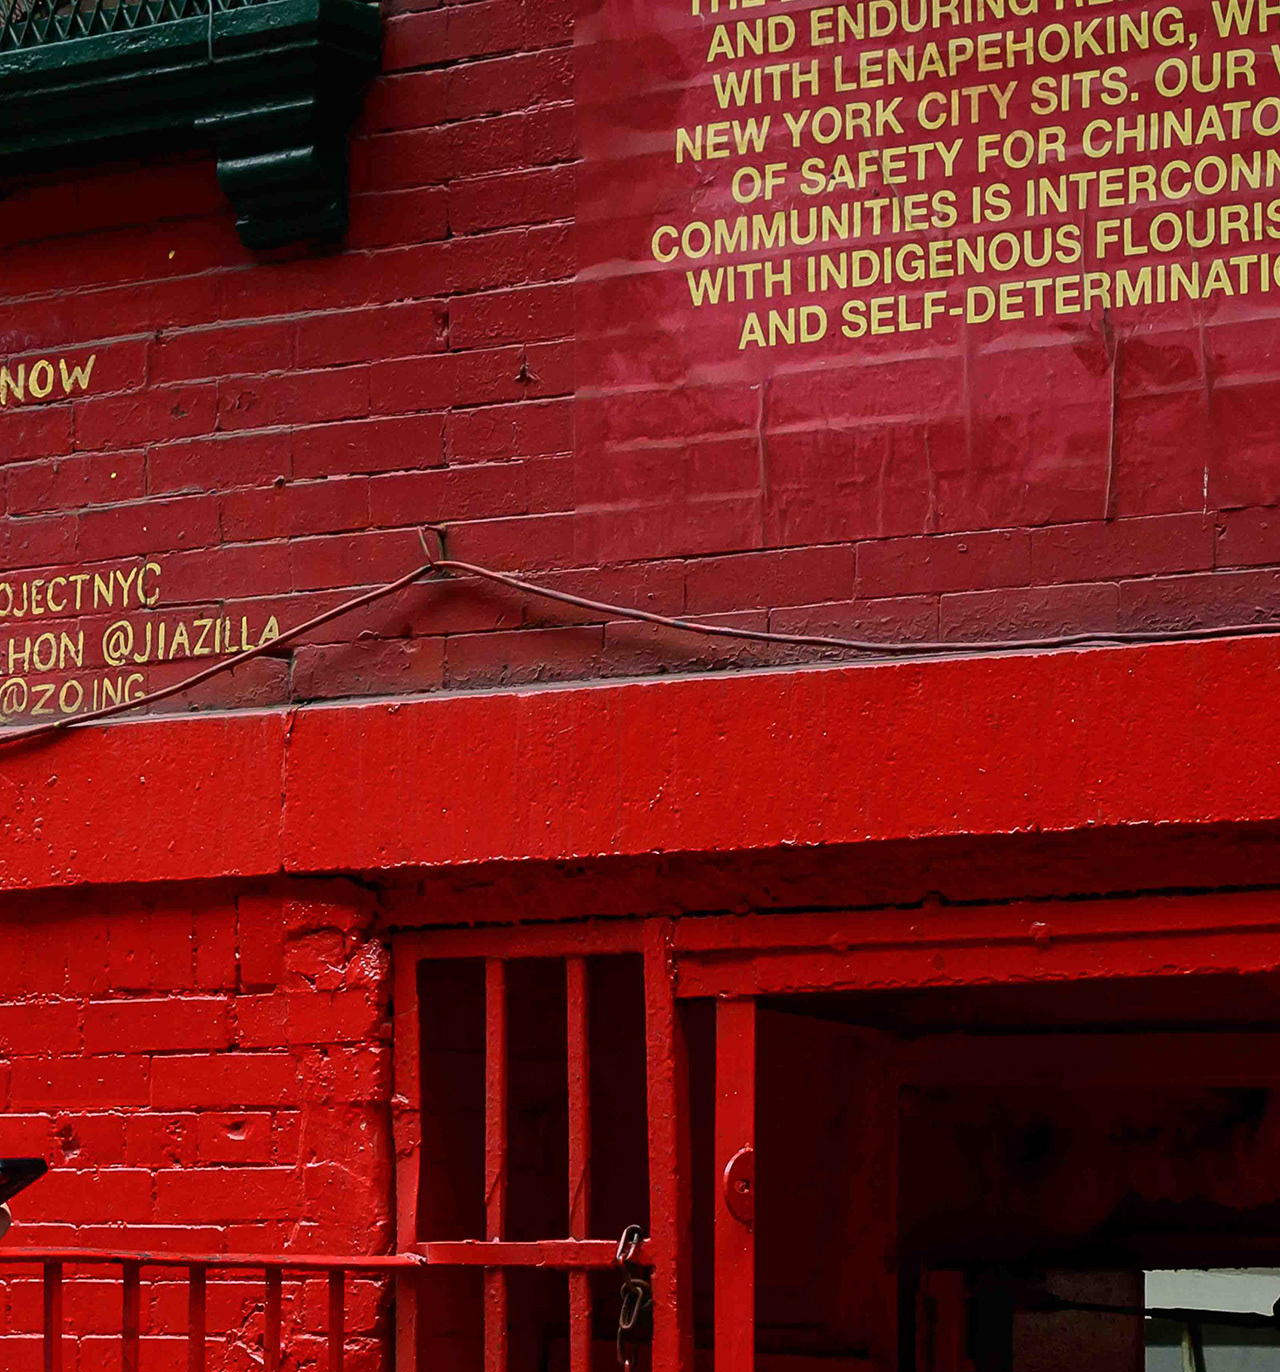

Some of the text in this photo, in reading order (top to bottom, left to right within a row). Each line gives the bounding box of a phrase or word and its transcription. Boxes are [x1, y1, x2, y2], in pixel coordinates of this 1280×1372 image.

[706, 15, 796, 62] AND
[712, 60, 819, 109] WITH
[834, 8, 1198, 92] LENAPEHOKING,
[676, 115, 771, 164] NEW
[783, 96, 904, 148] YORK
[917, 81, 1018, 130] CITY
[1031, 66, 1139, 115] SITS.
[1154, 48, 1256, 98] OUR
[731, 162, 787, 203] OF
[800, 138, 963, 195] SAFETY
[977, 125, 1067, 173] FOR
[651, 189, 958, 263] COMMUNITIES
[972, 183, 1012, 224] IS
[685, 258, 792, 307] WITH
[807, 224, 1082, 292] INDIGENOUS
[738, 305, 827, 349] AND
[103, 615, 280, 667] @JIAZILLA
